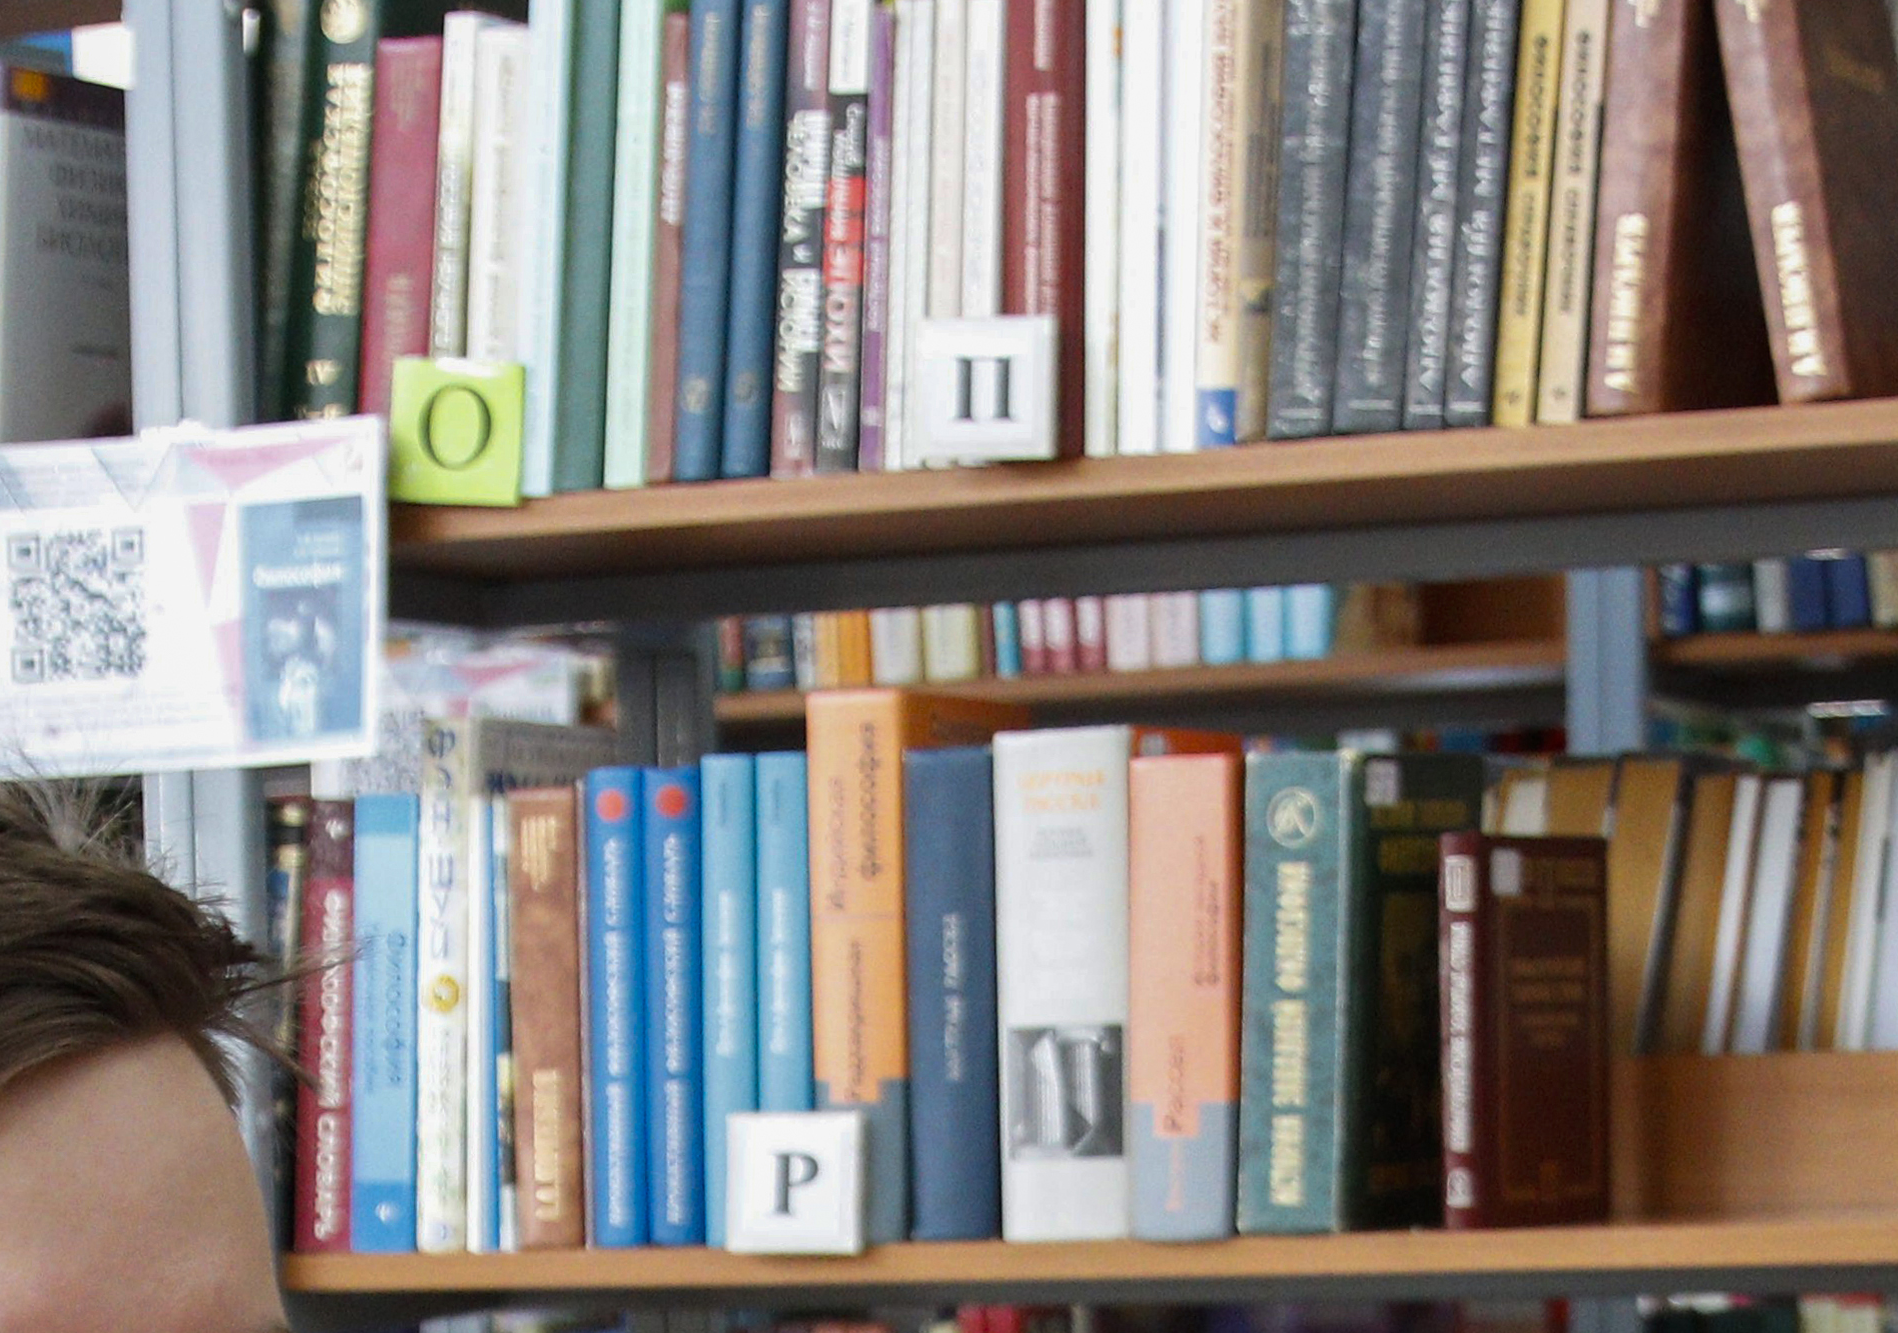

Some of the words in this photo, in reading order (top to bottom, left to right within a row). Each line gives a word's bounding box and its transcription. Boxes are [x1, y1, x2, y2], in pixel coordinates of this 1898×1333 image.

[955, 356, 1012, 422] П
[417, 383, 492, 470] О
[771, 1152, 820, 1217] Р
